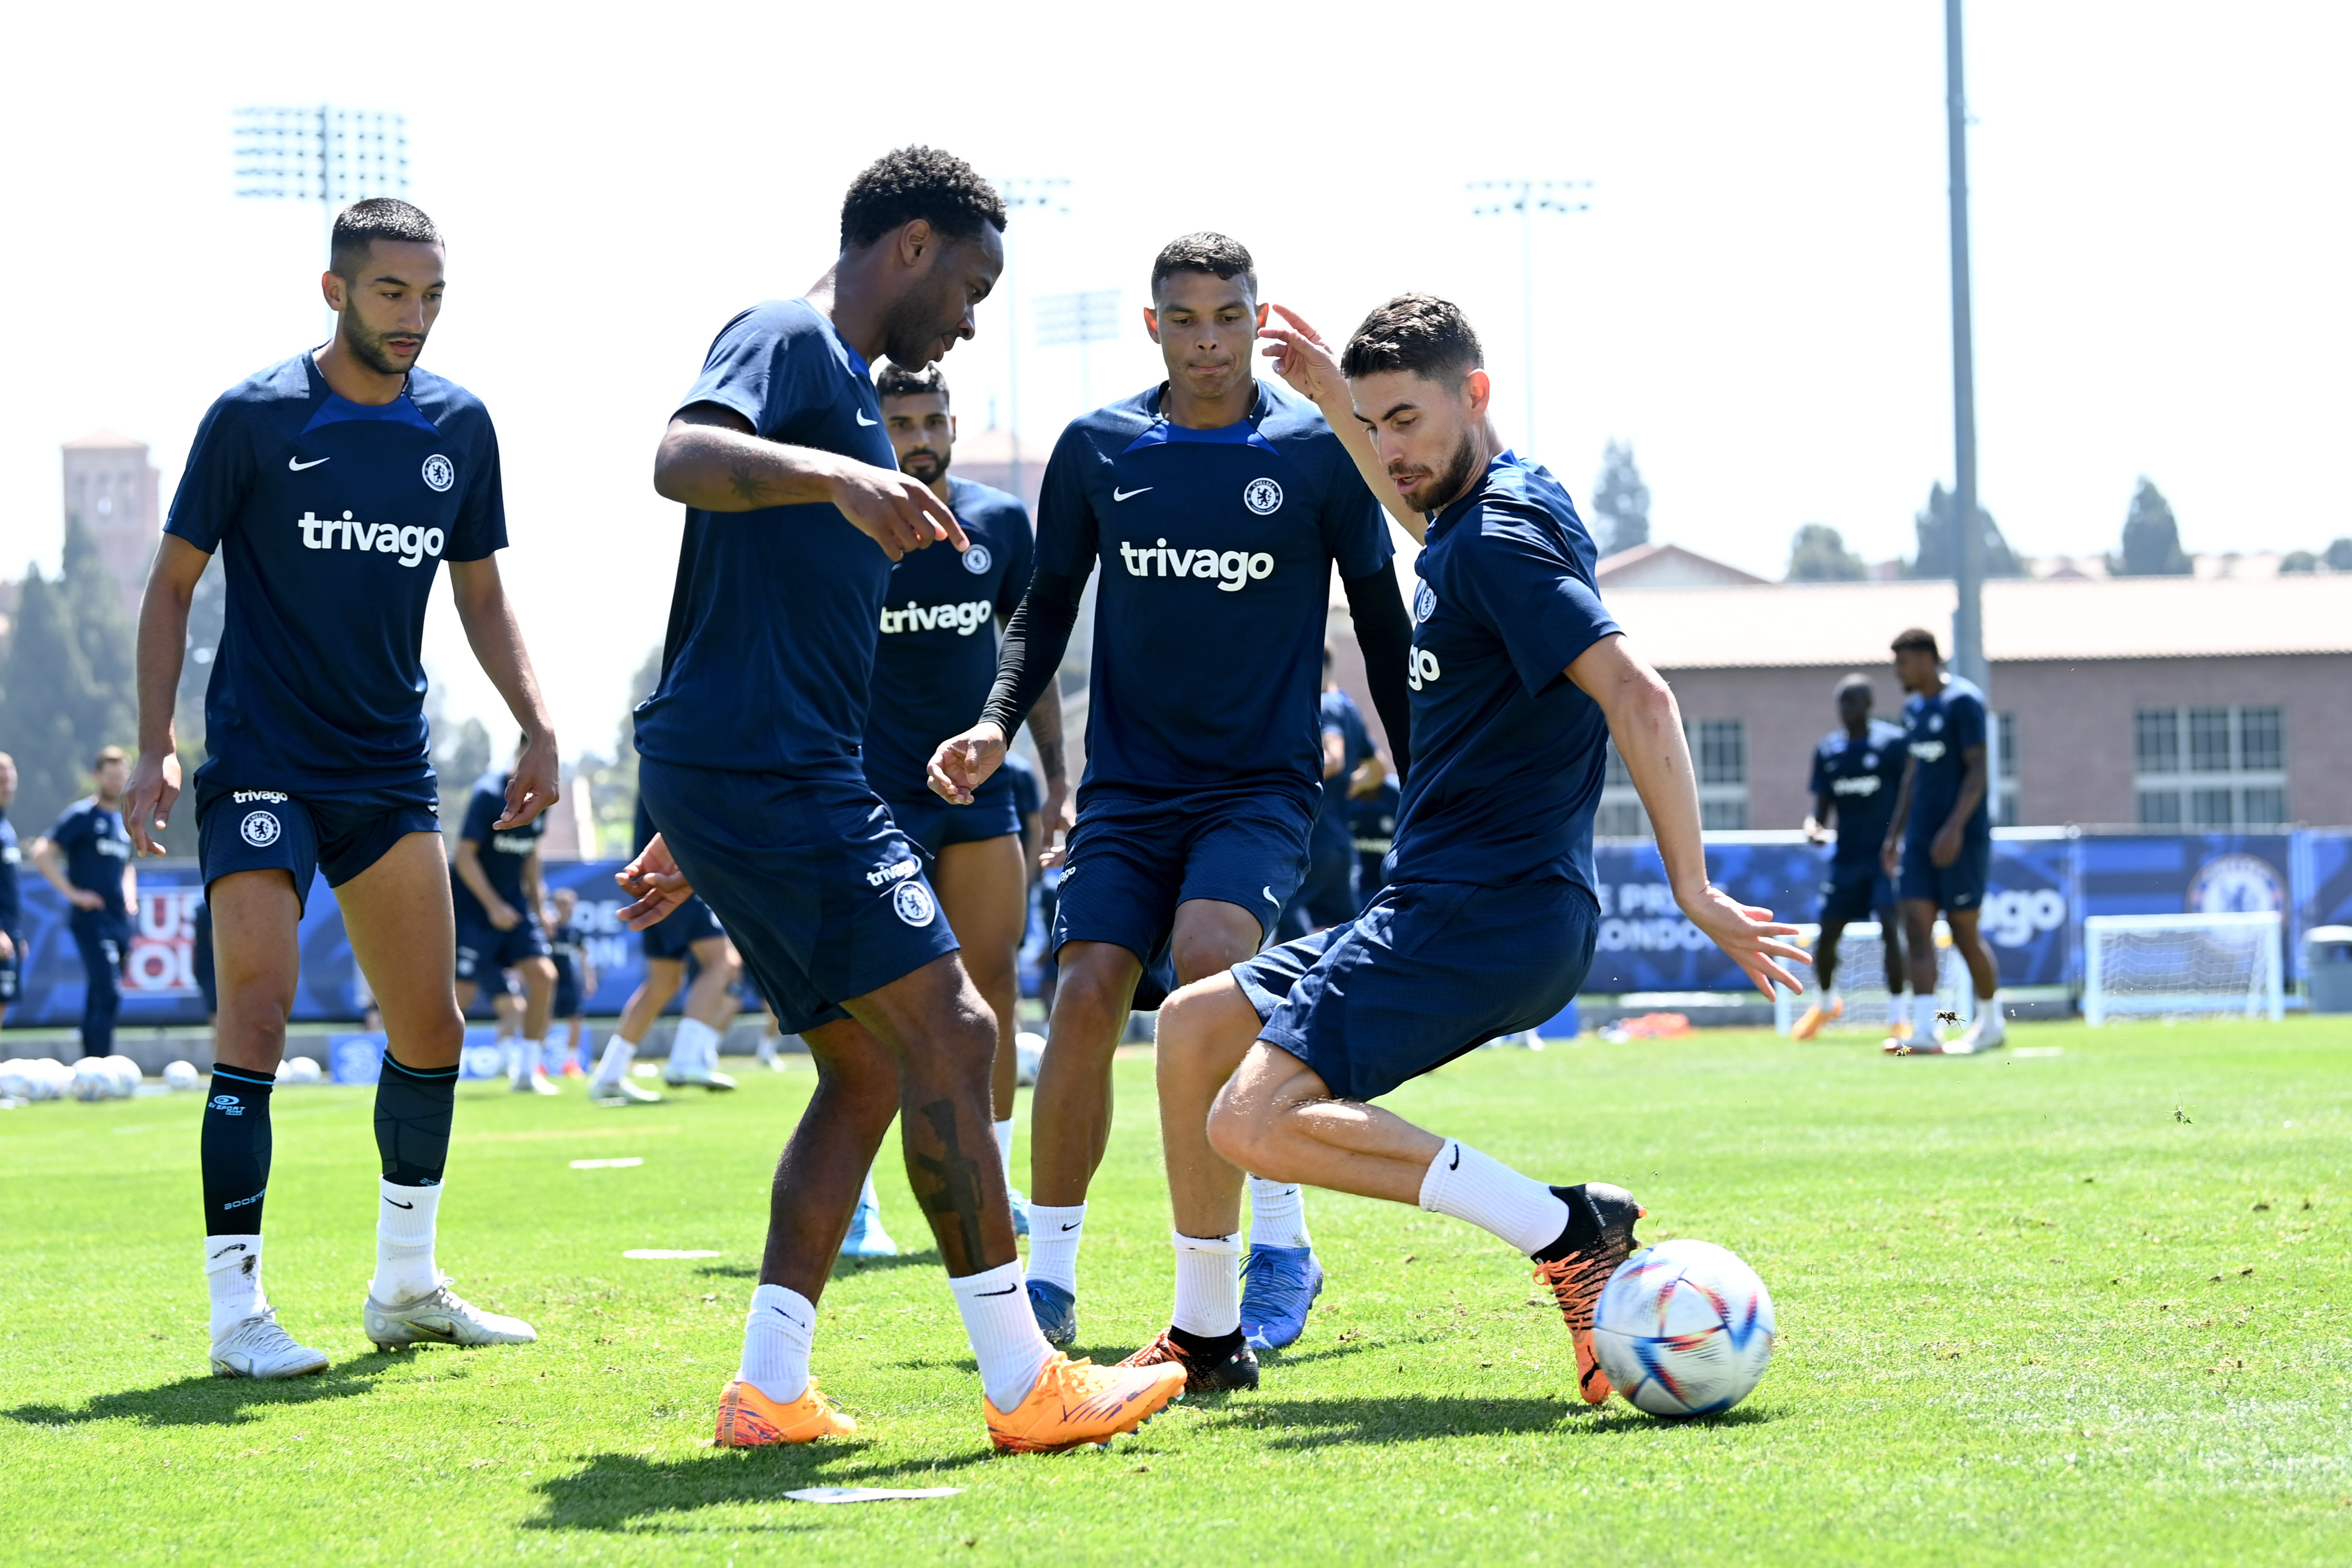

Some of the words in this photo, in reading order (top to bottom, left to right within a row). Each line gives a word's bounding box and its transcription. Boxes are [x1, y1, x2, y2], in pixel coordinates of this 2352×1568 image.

[1252, 481, 1275, 489] CHELSEA
[298, 510, 444, 568] trivago
[1120, 538, 1274, 592] trivago
[879, 601, 991, 636] trivago
[233, 789, 288, 804] trivago
[724, 1403, 737, 1427] FURON
